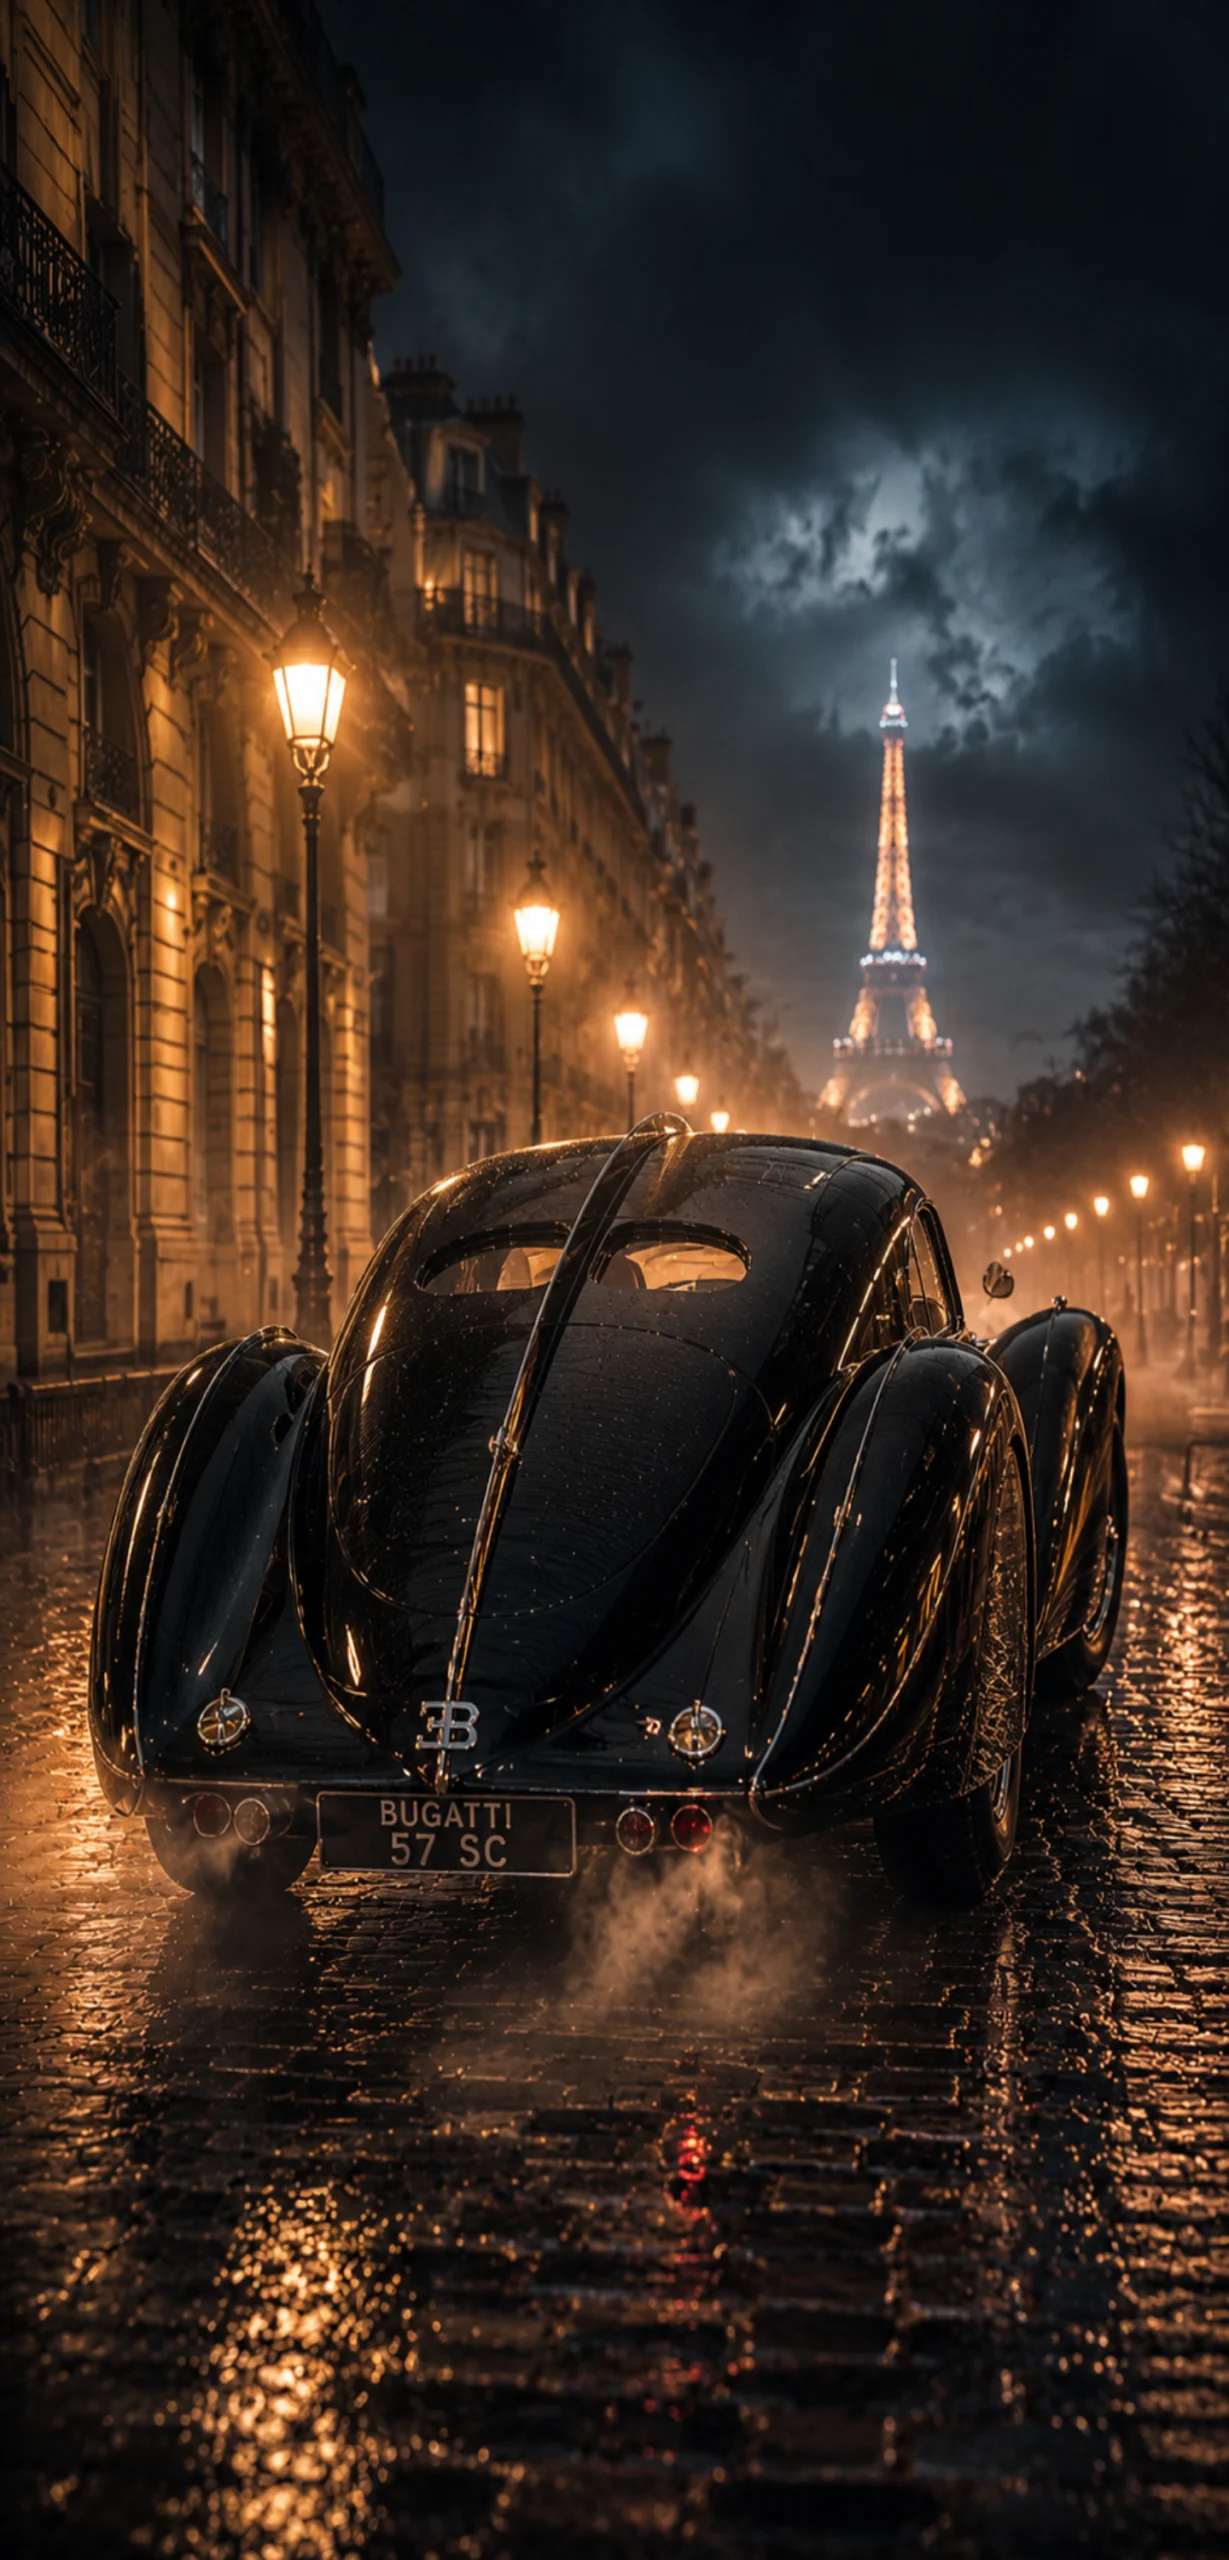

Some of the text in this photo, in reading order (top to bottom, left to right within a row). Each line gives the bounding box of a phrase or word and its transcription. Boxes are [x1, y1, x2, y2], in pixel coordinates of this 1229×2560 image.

[380, 1800, 512, 1829] BUGATTI
[391, 1832, 507, 1868] 57 SC
